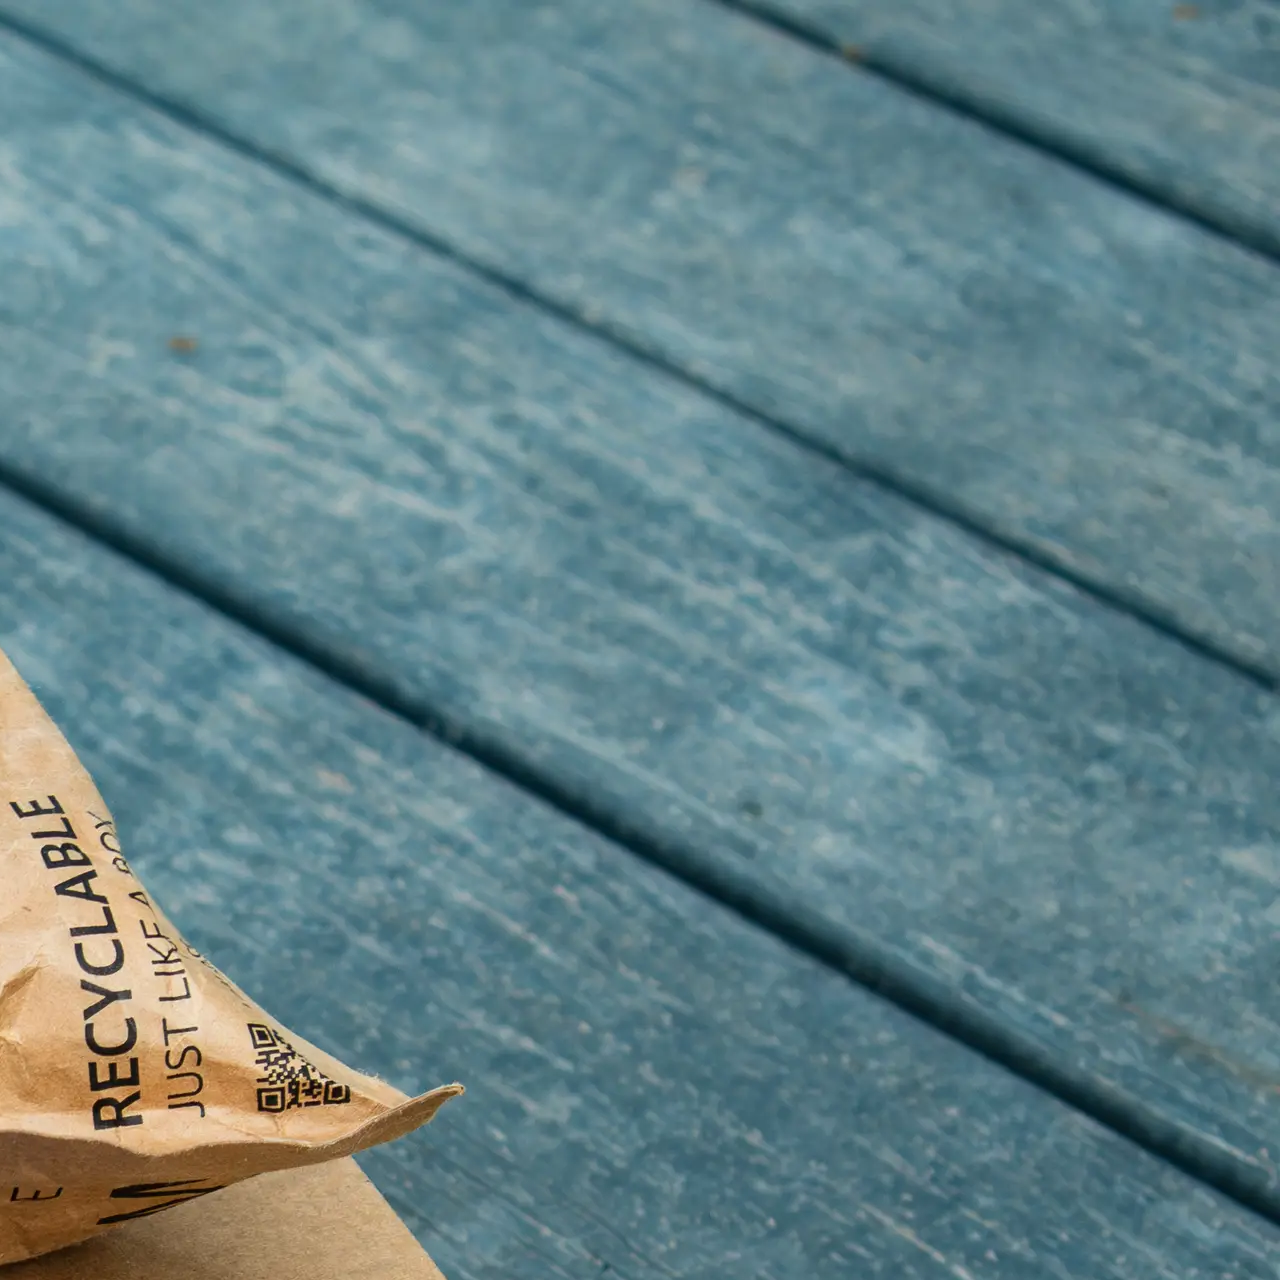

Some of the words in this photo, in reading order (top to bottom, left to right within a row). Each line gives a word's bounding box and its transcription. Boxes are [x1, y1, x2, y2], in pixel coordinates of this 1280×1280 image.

[9, 795, 144, 1131] RECYCLABLE
[140, 919, 192, 1002] LIKE
[162, 1017, 206, 1118] JUST
